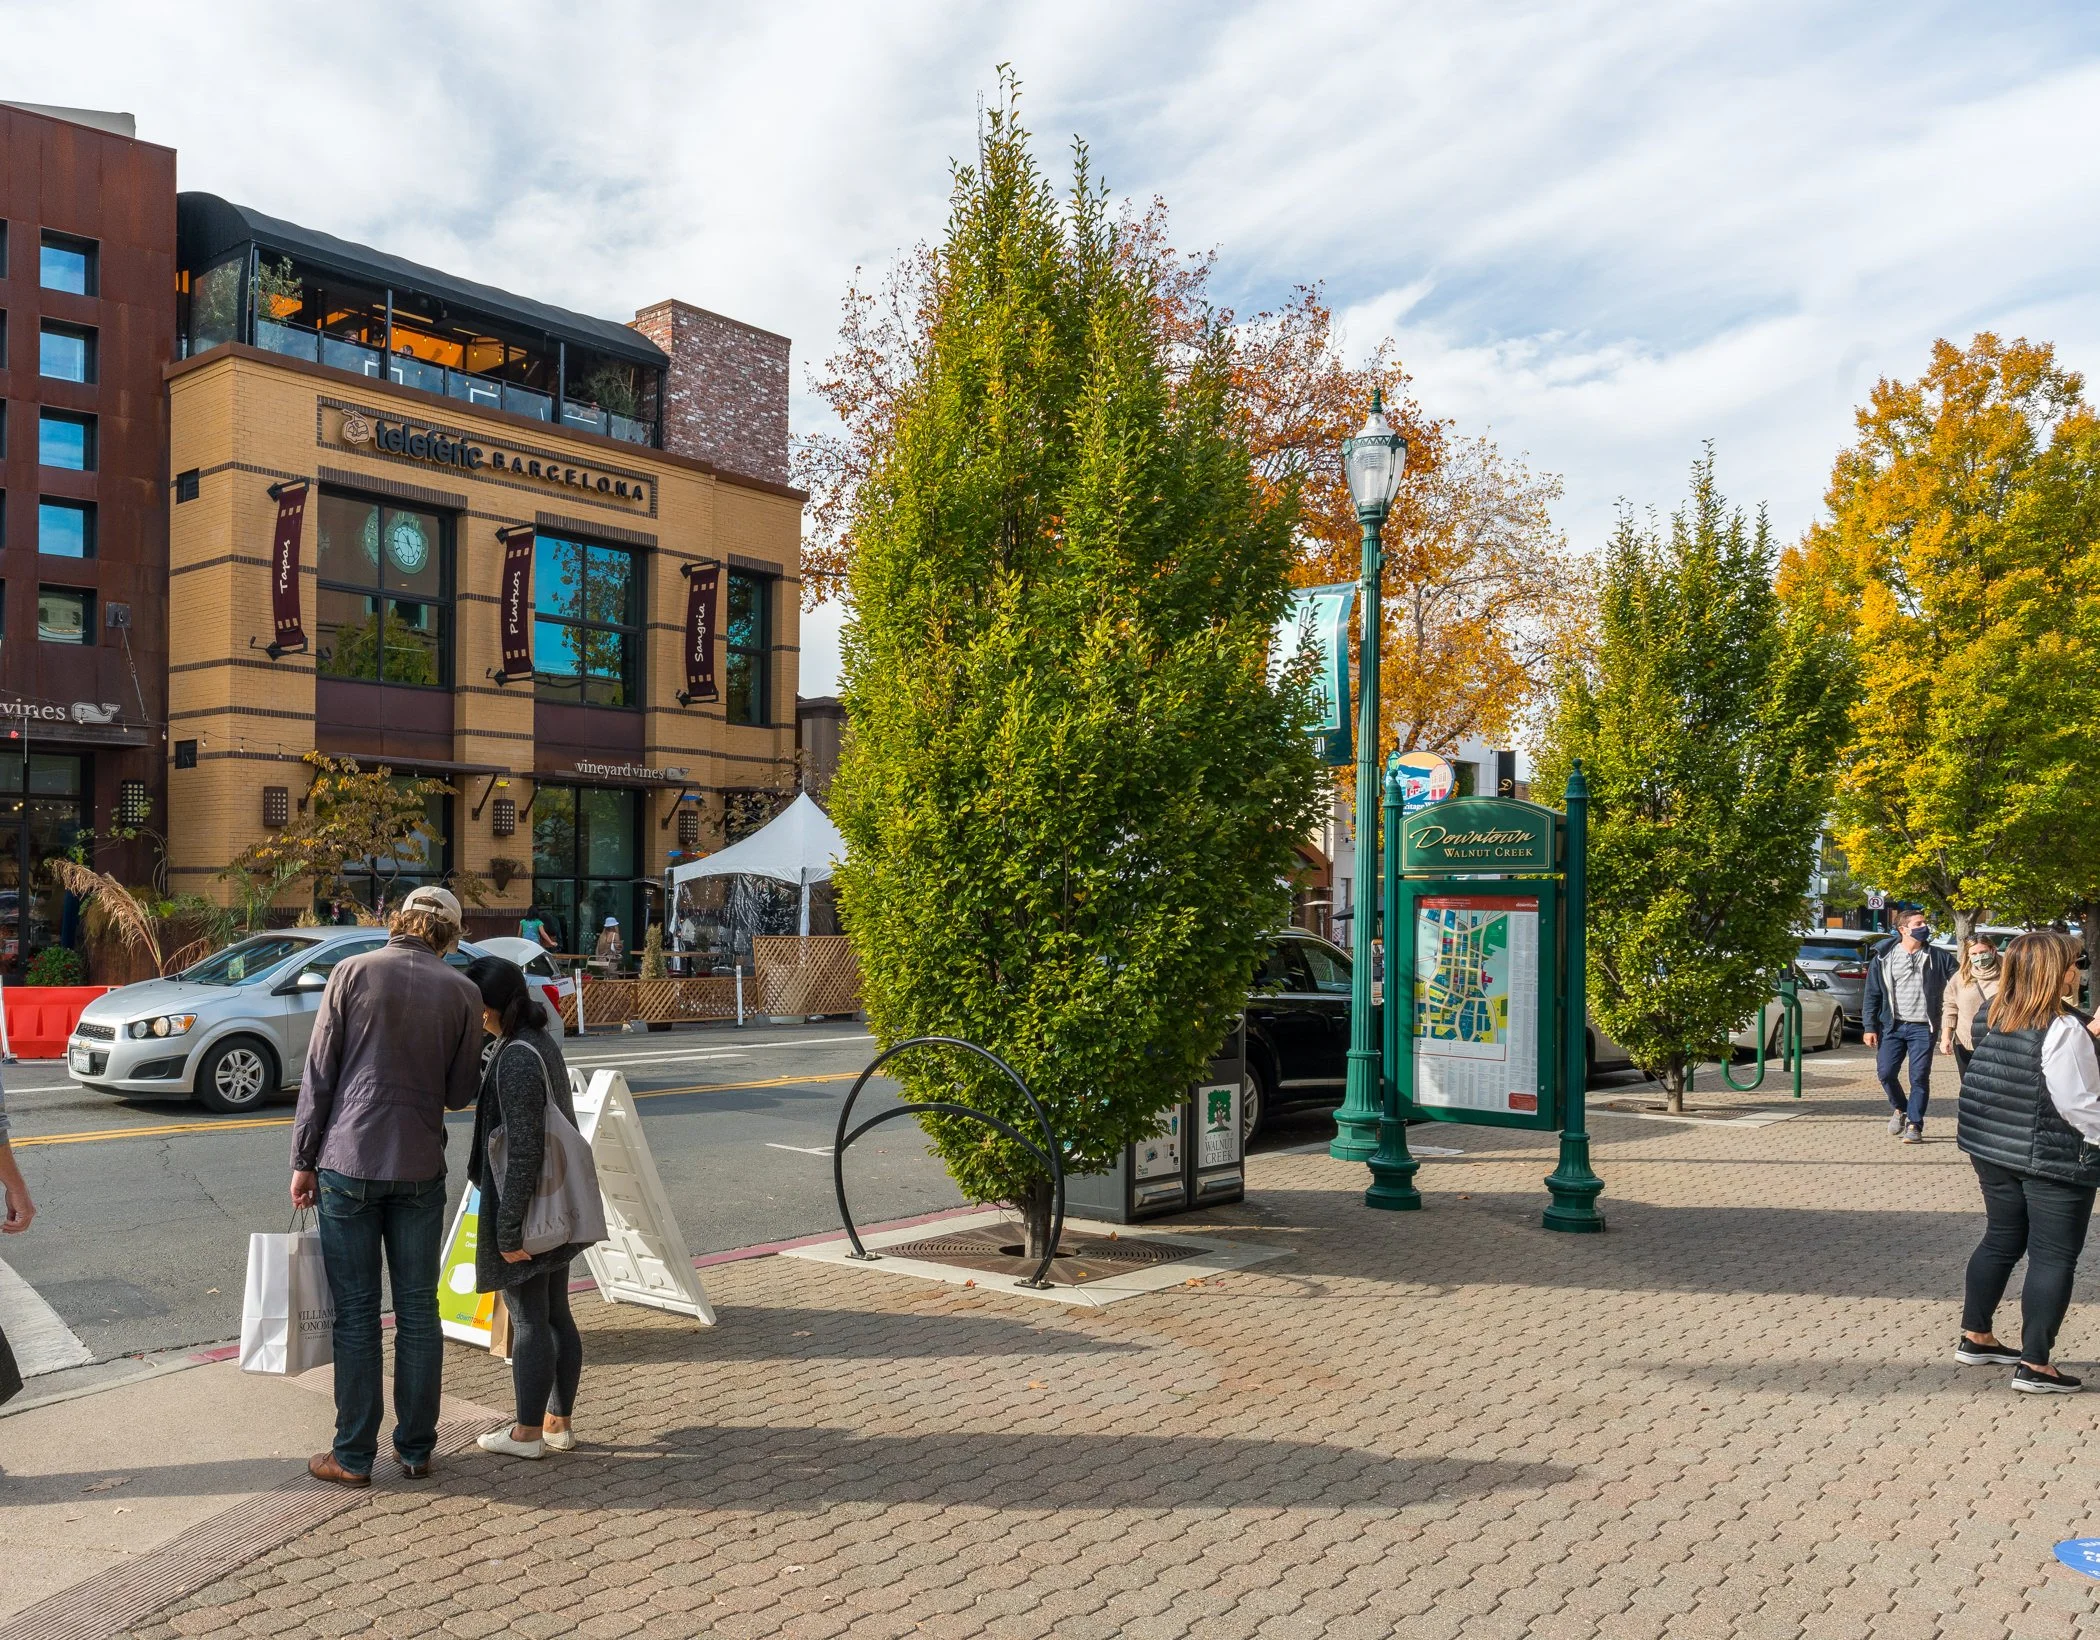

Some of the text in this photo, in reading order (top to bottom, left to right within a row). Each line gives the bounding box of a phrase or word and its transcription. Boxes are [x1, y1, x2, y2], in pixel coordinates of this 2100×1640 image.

[492, 451, 644, 501] BARCELONA
[279, 539, 291, 594] Tapas
[509, 570, 521, 636] Pintxos
[694, 602, 706, 663] Sangria
[1409, 825, 1536, 849] Downtown
[1443, 846, 1533, 858] WALNUT CREEK
[1204, 1137, 1234, 1153] WALNUT
[1205, 1149, 1234, 1165] CREEK
